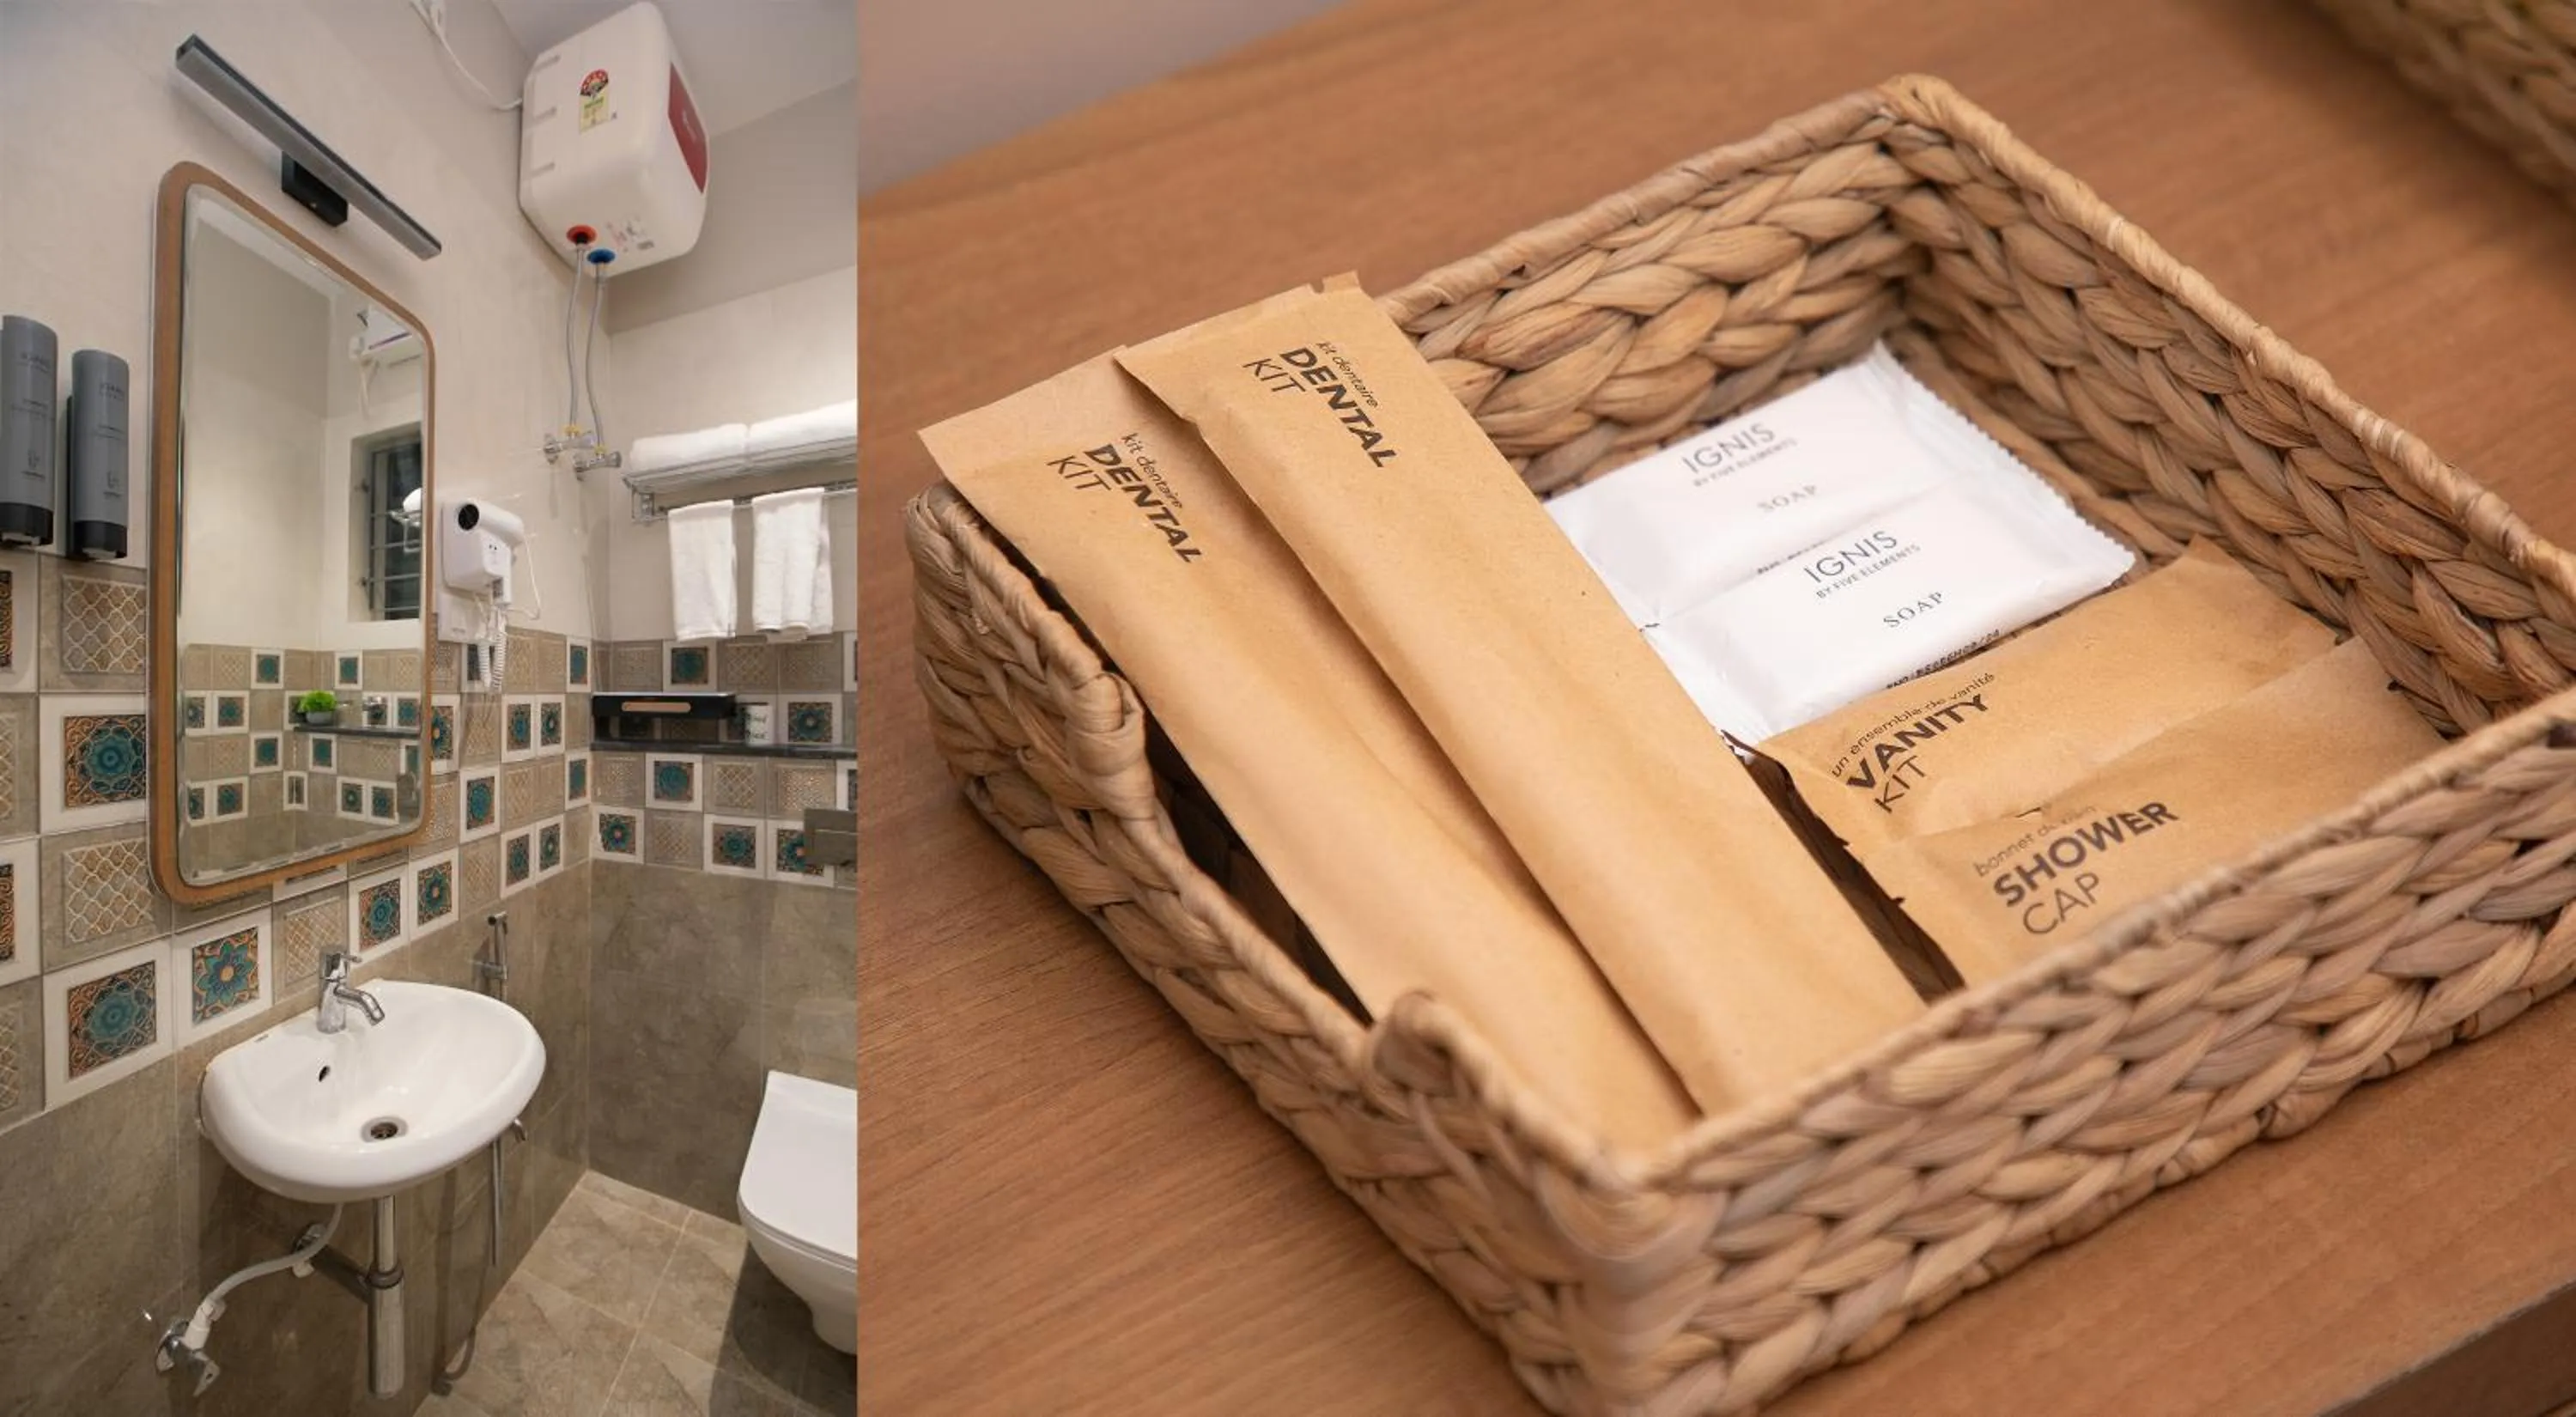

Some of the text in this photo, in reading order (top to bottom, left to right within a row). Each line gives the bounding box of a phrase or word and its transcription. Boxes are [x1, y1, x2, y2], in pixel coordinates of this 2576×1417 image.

[1242, 357, 1306, 393] KIT
[1332, 356, 1379, 408] dentaire
[1279, 347, 1400, 468] DENTAL
[1047, 455, 1113, 492] KIT
[1121, 433, 1183, 509] kit dentaire
[1681, 423, 1776, 474] IGNIS
[1083, 444, 1202, 563] DENTAL
[1757, 484, 1817, 513] SOAP
[1803, 530, 1898, 583] IGNIS
[1816, 544, 1922, 599] BY FIVE ELEMENTS
[1883, 591, 1943, 628] SOAP
[1832, 672, 1996, 778] un ensemble de vanité
[1846, 693, 1989, 789] VANITY
[1873, 754, 1927, 813] KIT
[1973, 833, 2035, 877] bonnet
[1992, 800, 2180, 908] SHOWER
[2022, 872, 2099, 935] CAP
